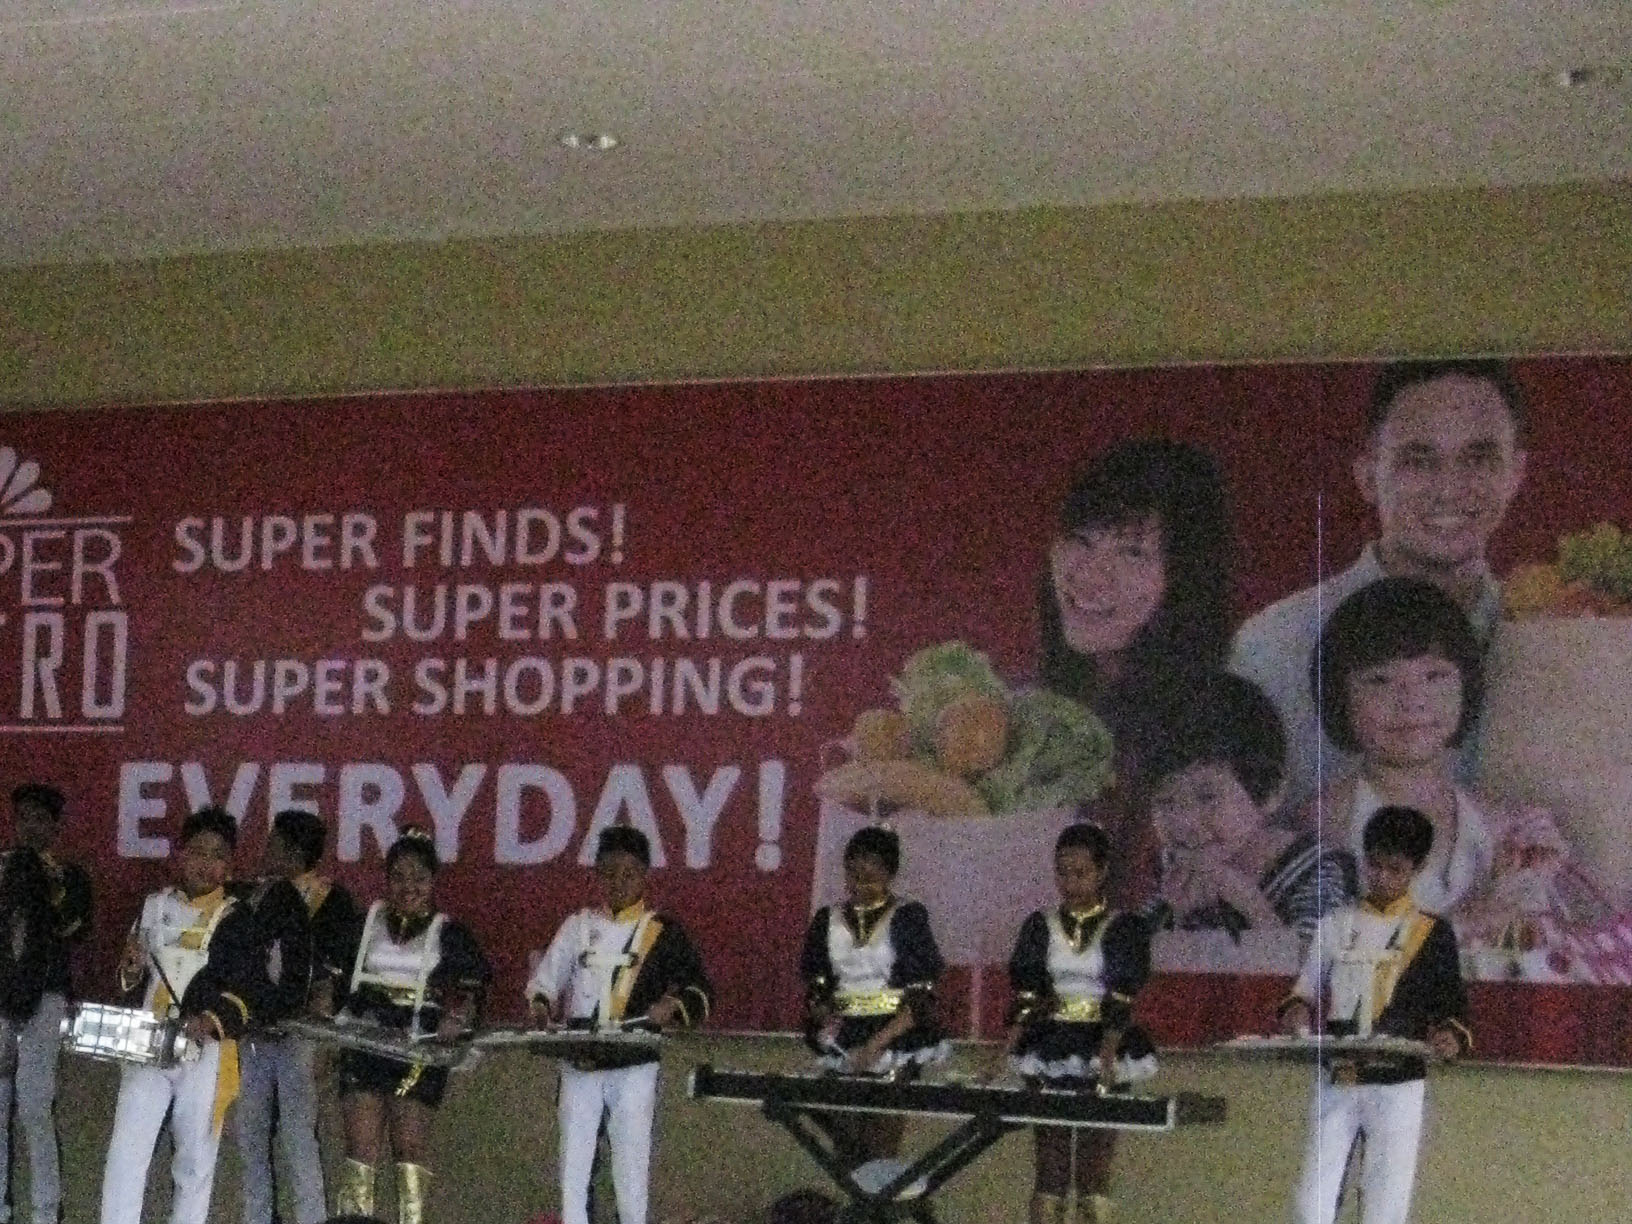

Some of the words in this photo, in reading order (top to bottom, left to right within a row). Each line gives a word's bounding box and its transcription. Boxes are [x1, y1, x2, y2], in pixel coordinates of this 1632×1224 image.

[172, 512, 378, 573] SUPER
[403, 503, 625, 568] FINDS!
[361, 580, 578, 642] SUPER
[604, 574, 868, 640] PRICES!
[184, 658, 391, 716] SUPER
[412, 652, 804, 717] SHOPPING!
